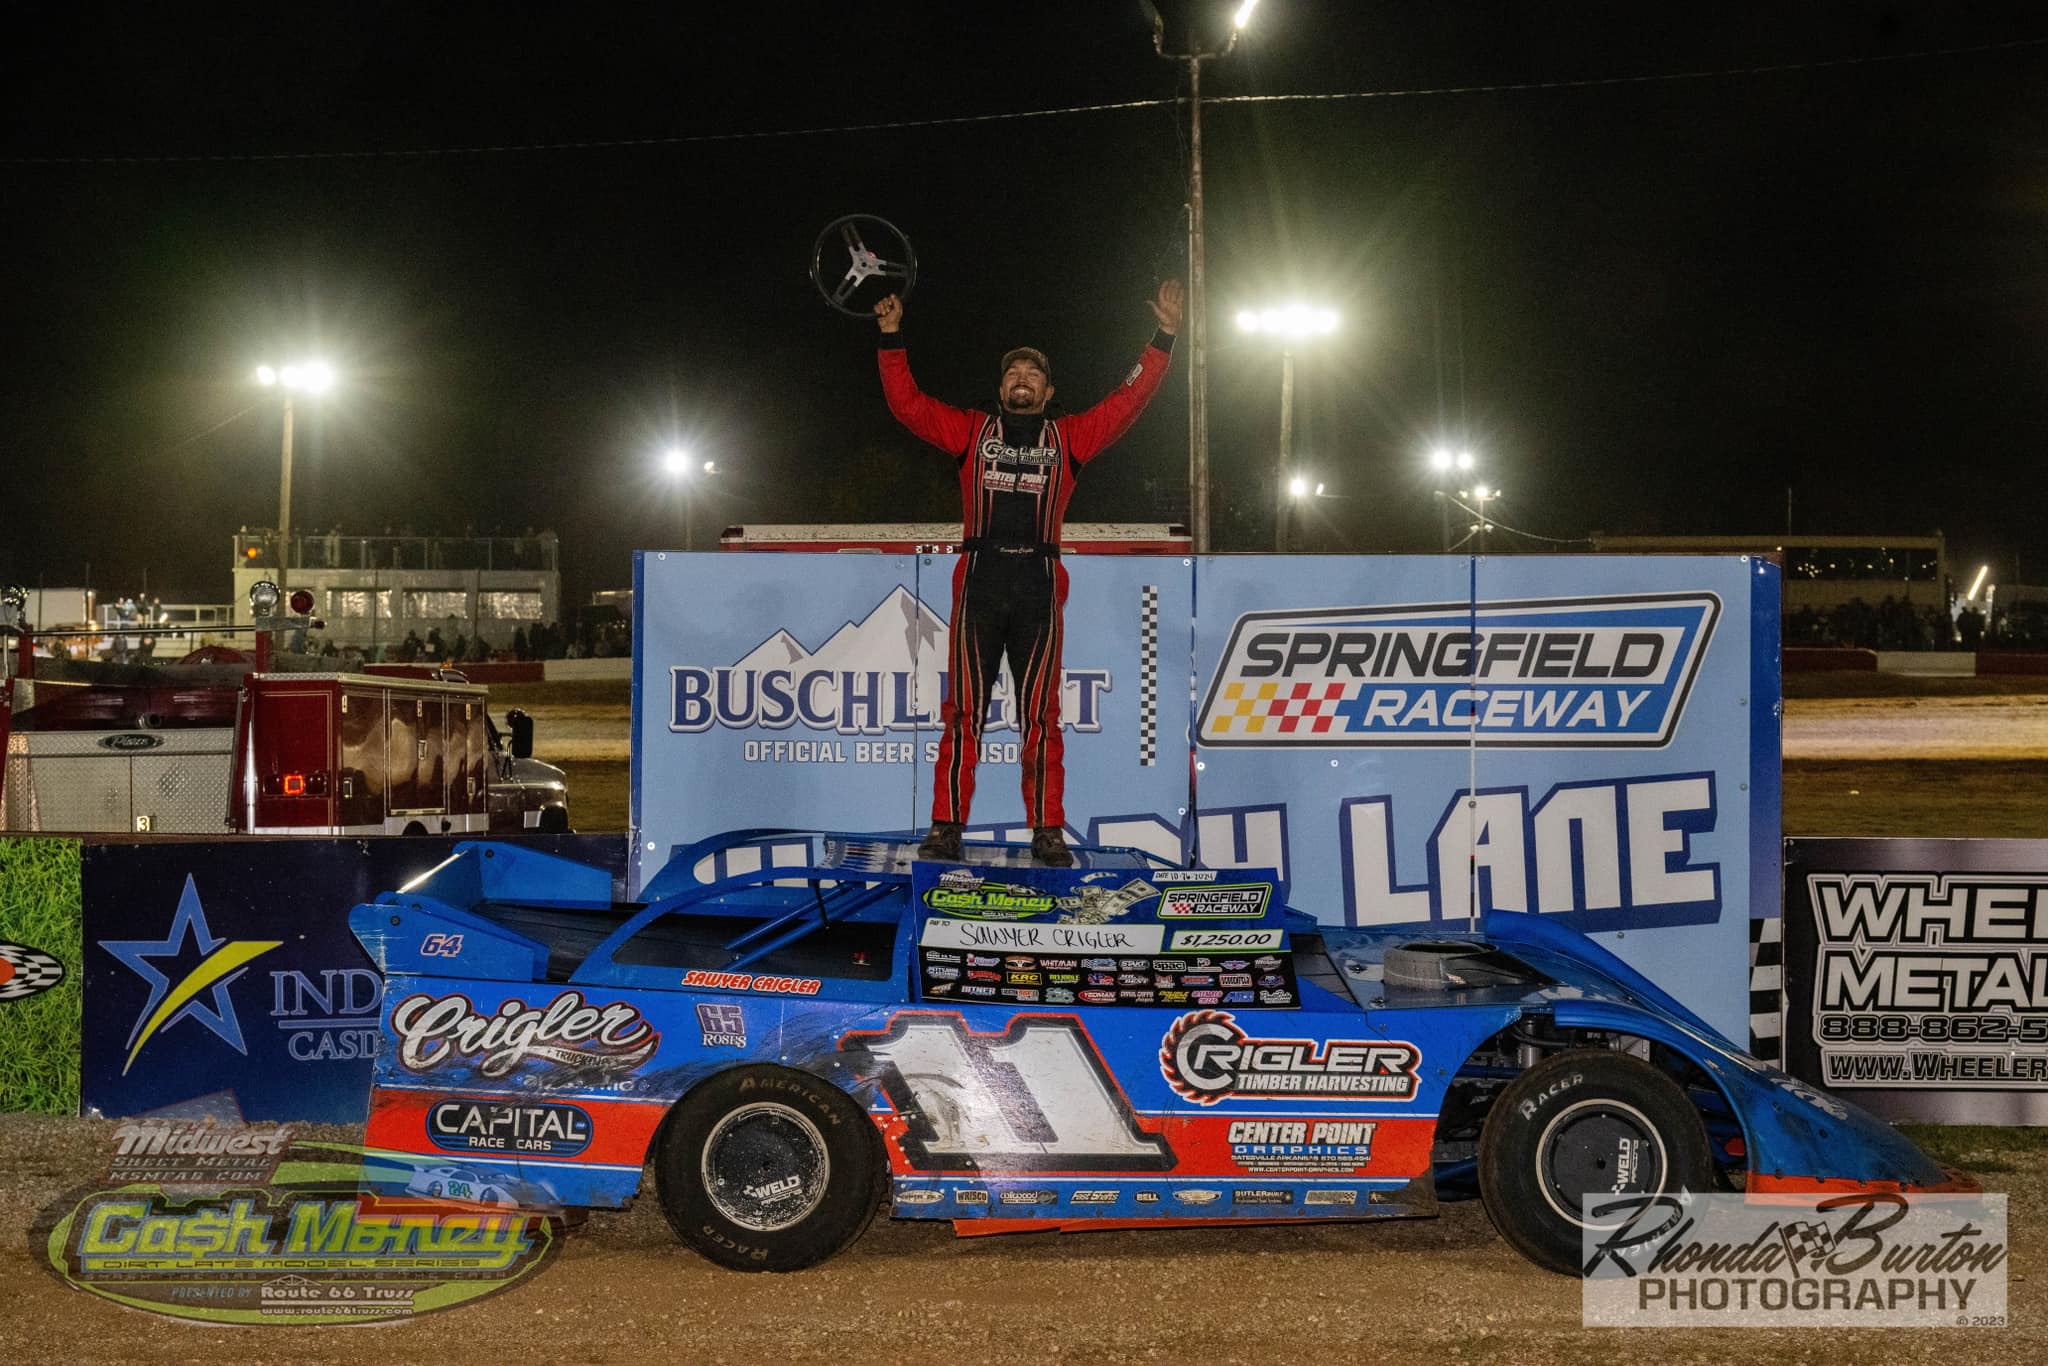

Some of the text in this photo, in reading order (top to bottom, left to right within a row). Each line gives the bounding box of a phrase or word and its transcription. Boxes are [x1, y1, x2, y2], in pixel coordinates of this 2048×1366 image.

[1240, 631, 1665, 679] SPRINGFIELD
[669, 666, 886, 736] BUSCH
[1363, 687, 1650, 728] RACEWAY
[744, 740, 848, 763] OFFICIAL
[855, 741, 914, 764] BEER
[1341, 771, 1722, 929] LANE
[1167, 892, 1259, 903] SPRINGFIELD
[1195, 904, 1257, 914] RACEWAY
[421, 933, 464, 957] 64
[1053, 928, 1136, 949] CRIGLER
[1180, 933, 1272, 948] $1,250.00
[682, 970, 821, 995] SAWYER CRIGLER
[1010, 973, 1039, 981] KRC
[394, 992, 648, 1077] Crigler
[702, 1034, 747, 1049] ROSES
[1176, 1023, 1411, 1090] CRIGLER
[855, 1018, 1172, 1163] 11
[1237, 1073, 1410, 1093] TIMBER HARVESTING
[738, 1075, 842, 1127] AMERICAN
[1518, 1072, 1585, 1121] RACER
[436, 1103, 586, 1141] CAPITAL
[1227, 1121, 1377, 1145] CENTER POINT
[468, 1136, 552, 1151] RACE CARS
[1234, 1145, 1369, 1155] GRAPHICS
[1616, 1137, 1631, 1186] WELD
[755, 1174, 801, 1199] WELD
[957, 1191, 987, 1201] WRISCO
[1136, 1192, 1160, 1202] BELL
[702, 1223, 769, 1252] RACER
